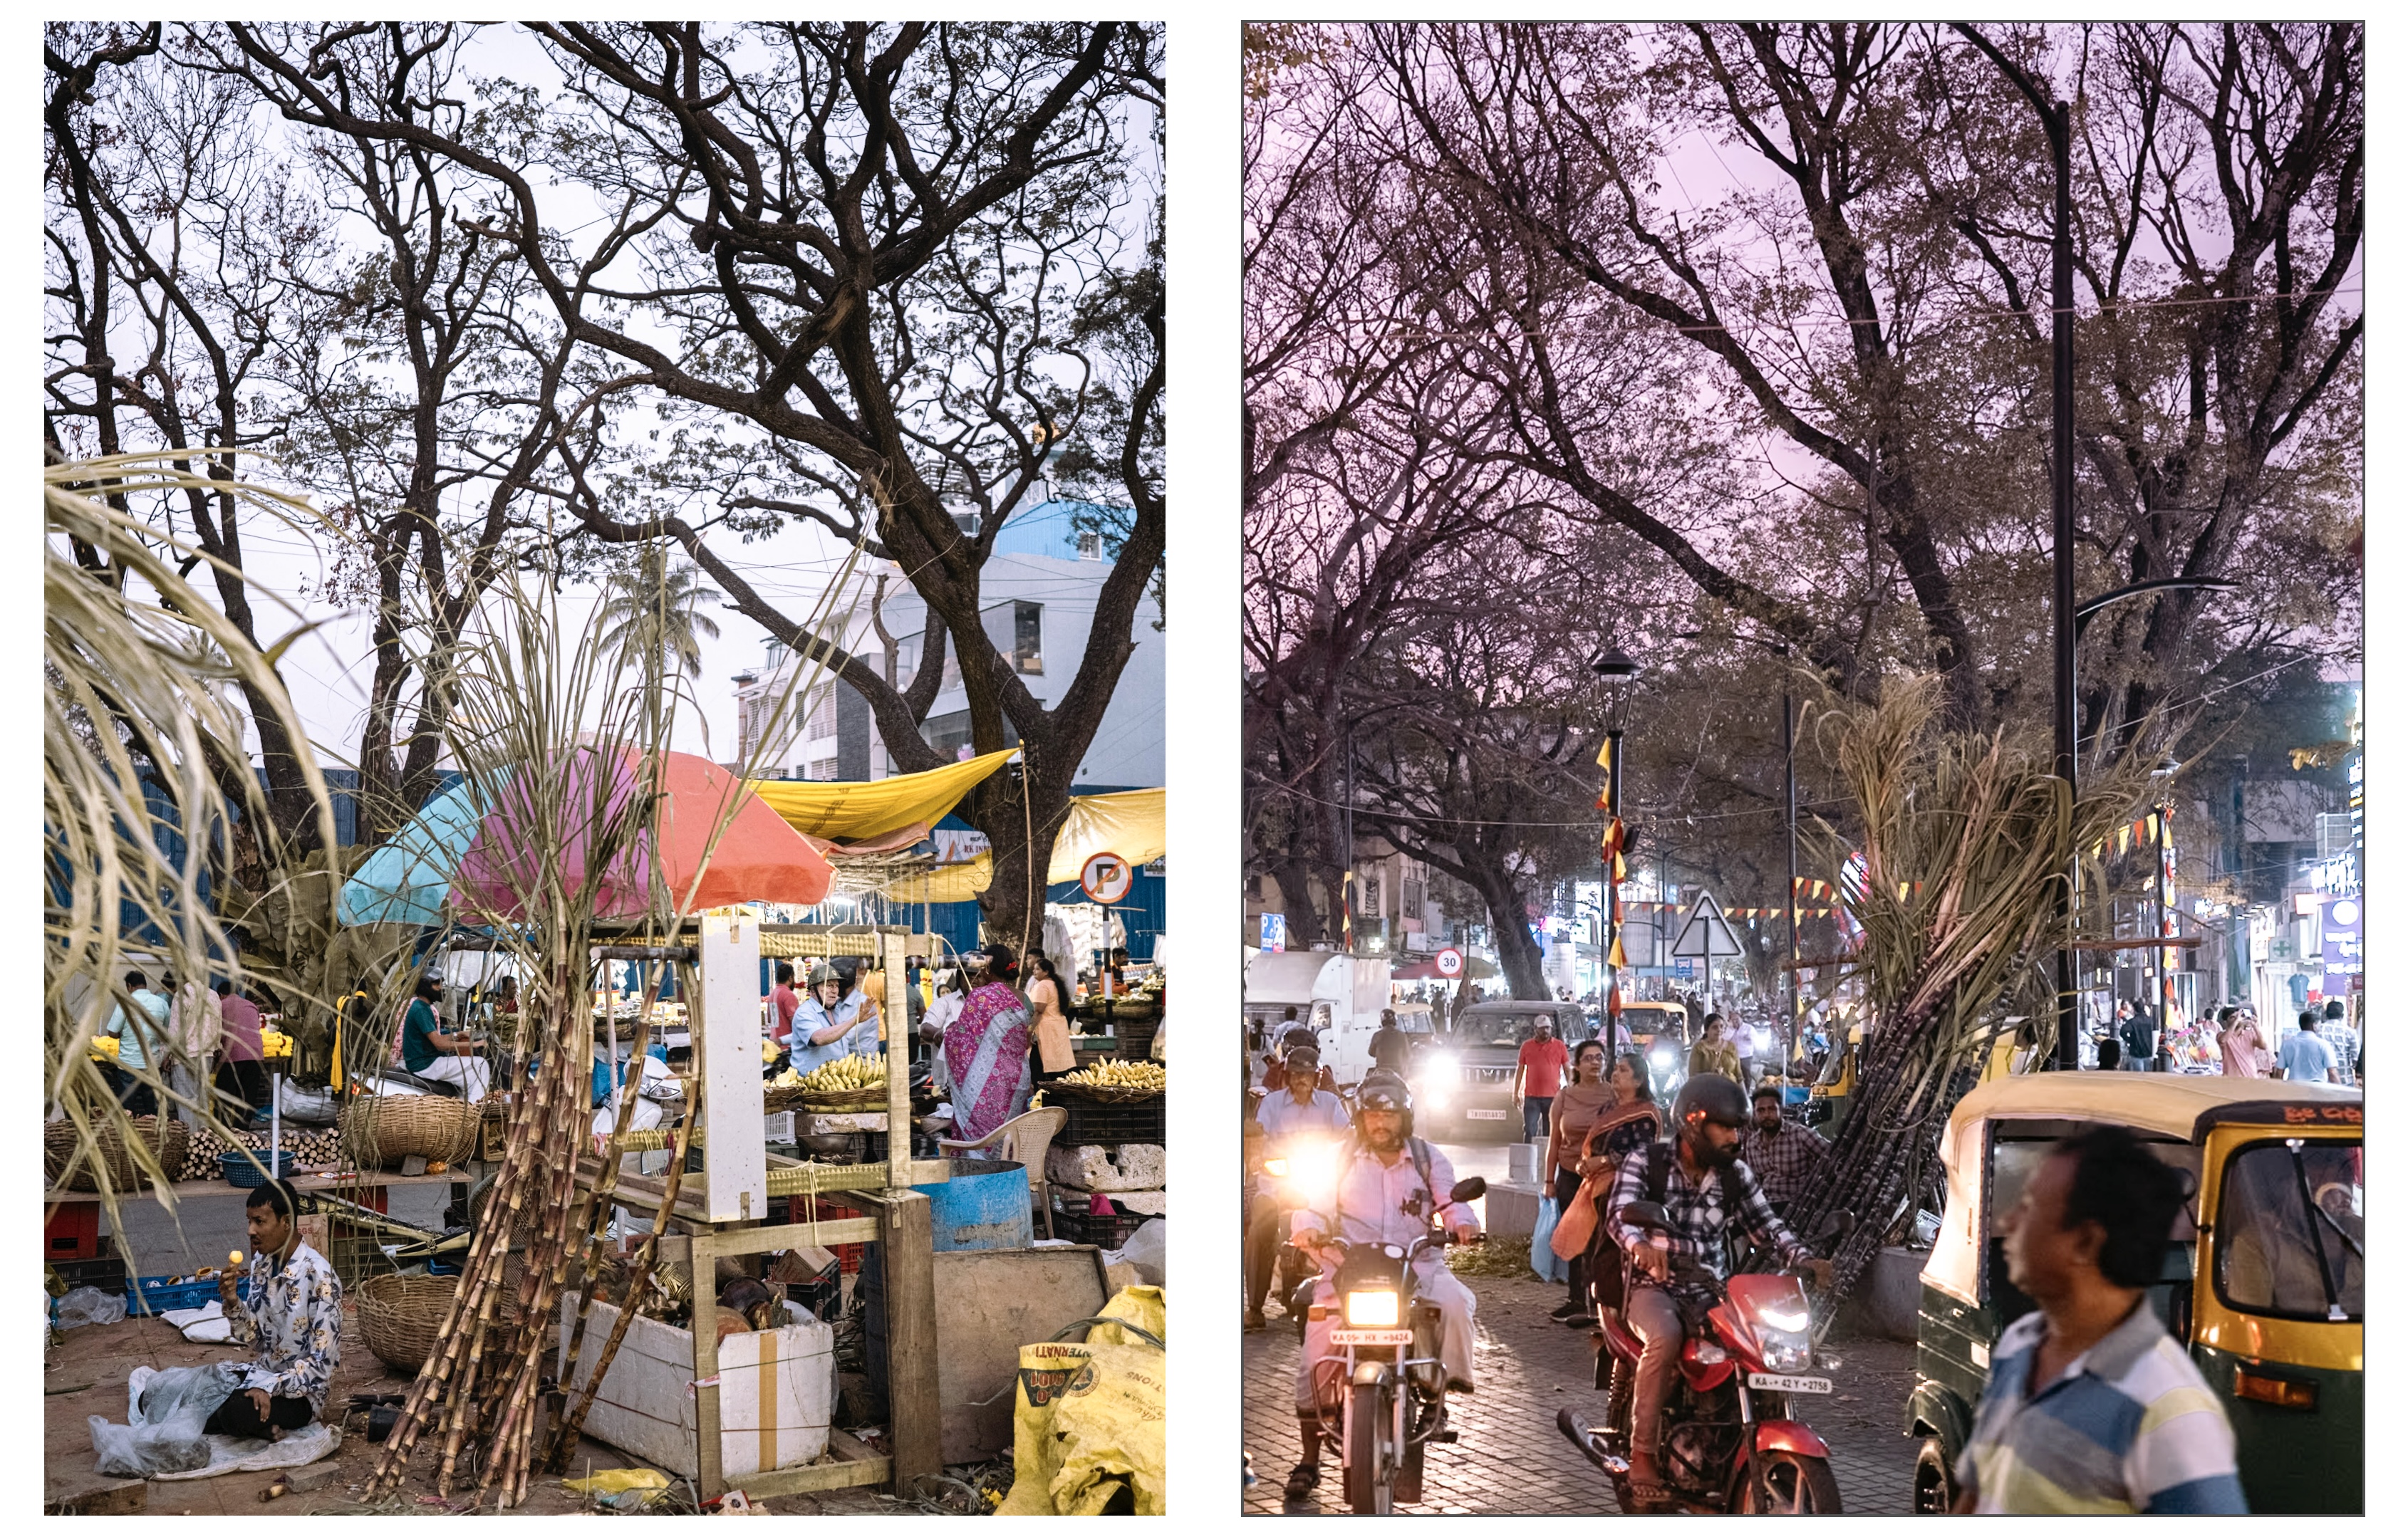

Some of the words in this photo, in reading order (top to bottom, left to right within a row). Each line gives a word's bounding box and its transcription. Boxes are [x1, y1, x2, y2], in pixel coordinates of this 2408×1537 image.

[964, 845, 974, 853] RK
[1096, 864, 1121, 894] P
[1443, 957, 1456, 967] 30
[1755, 1377, 1768, 1386] KA
[1782, 1379, 1792, 1388] 42
[1793, 1380, 1800, 1388] Y
